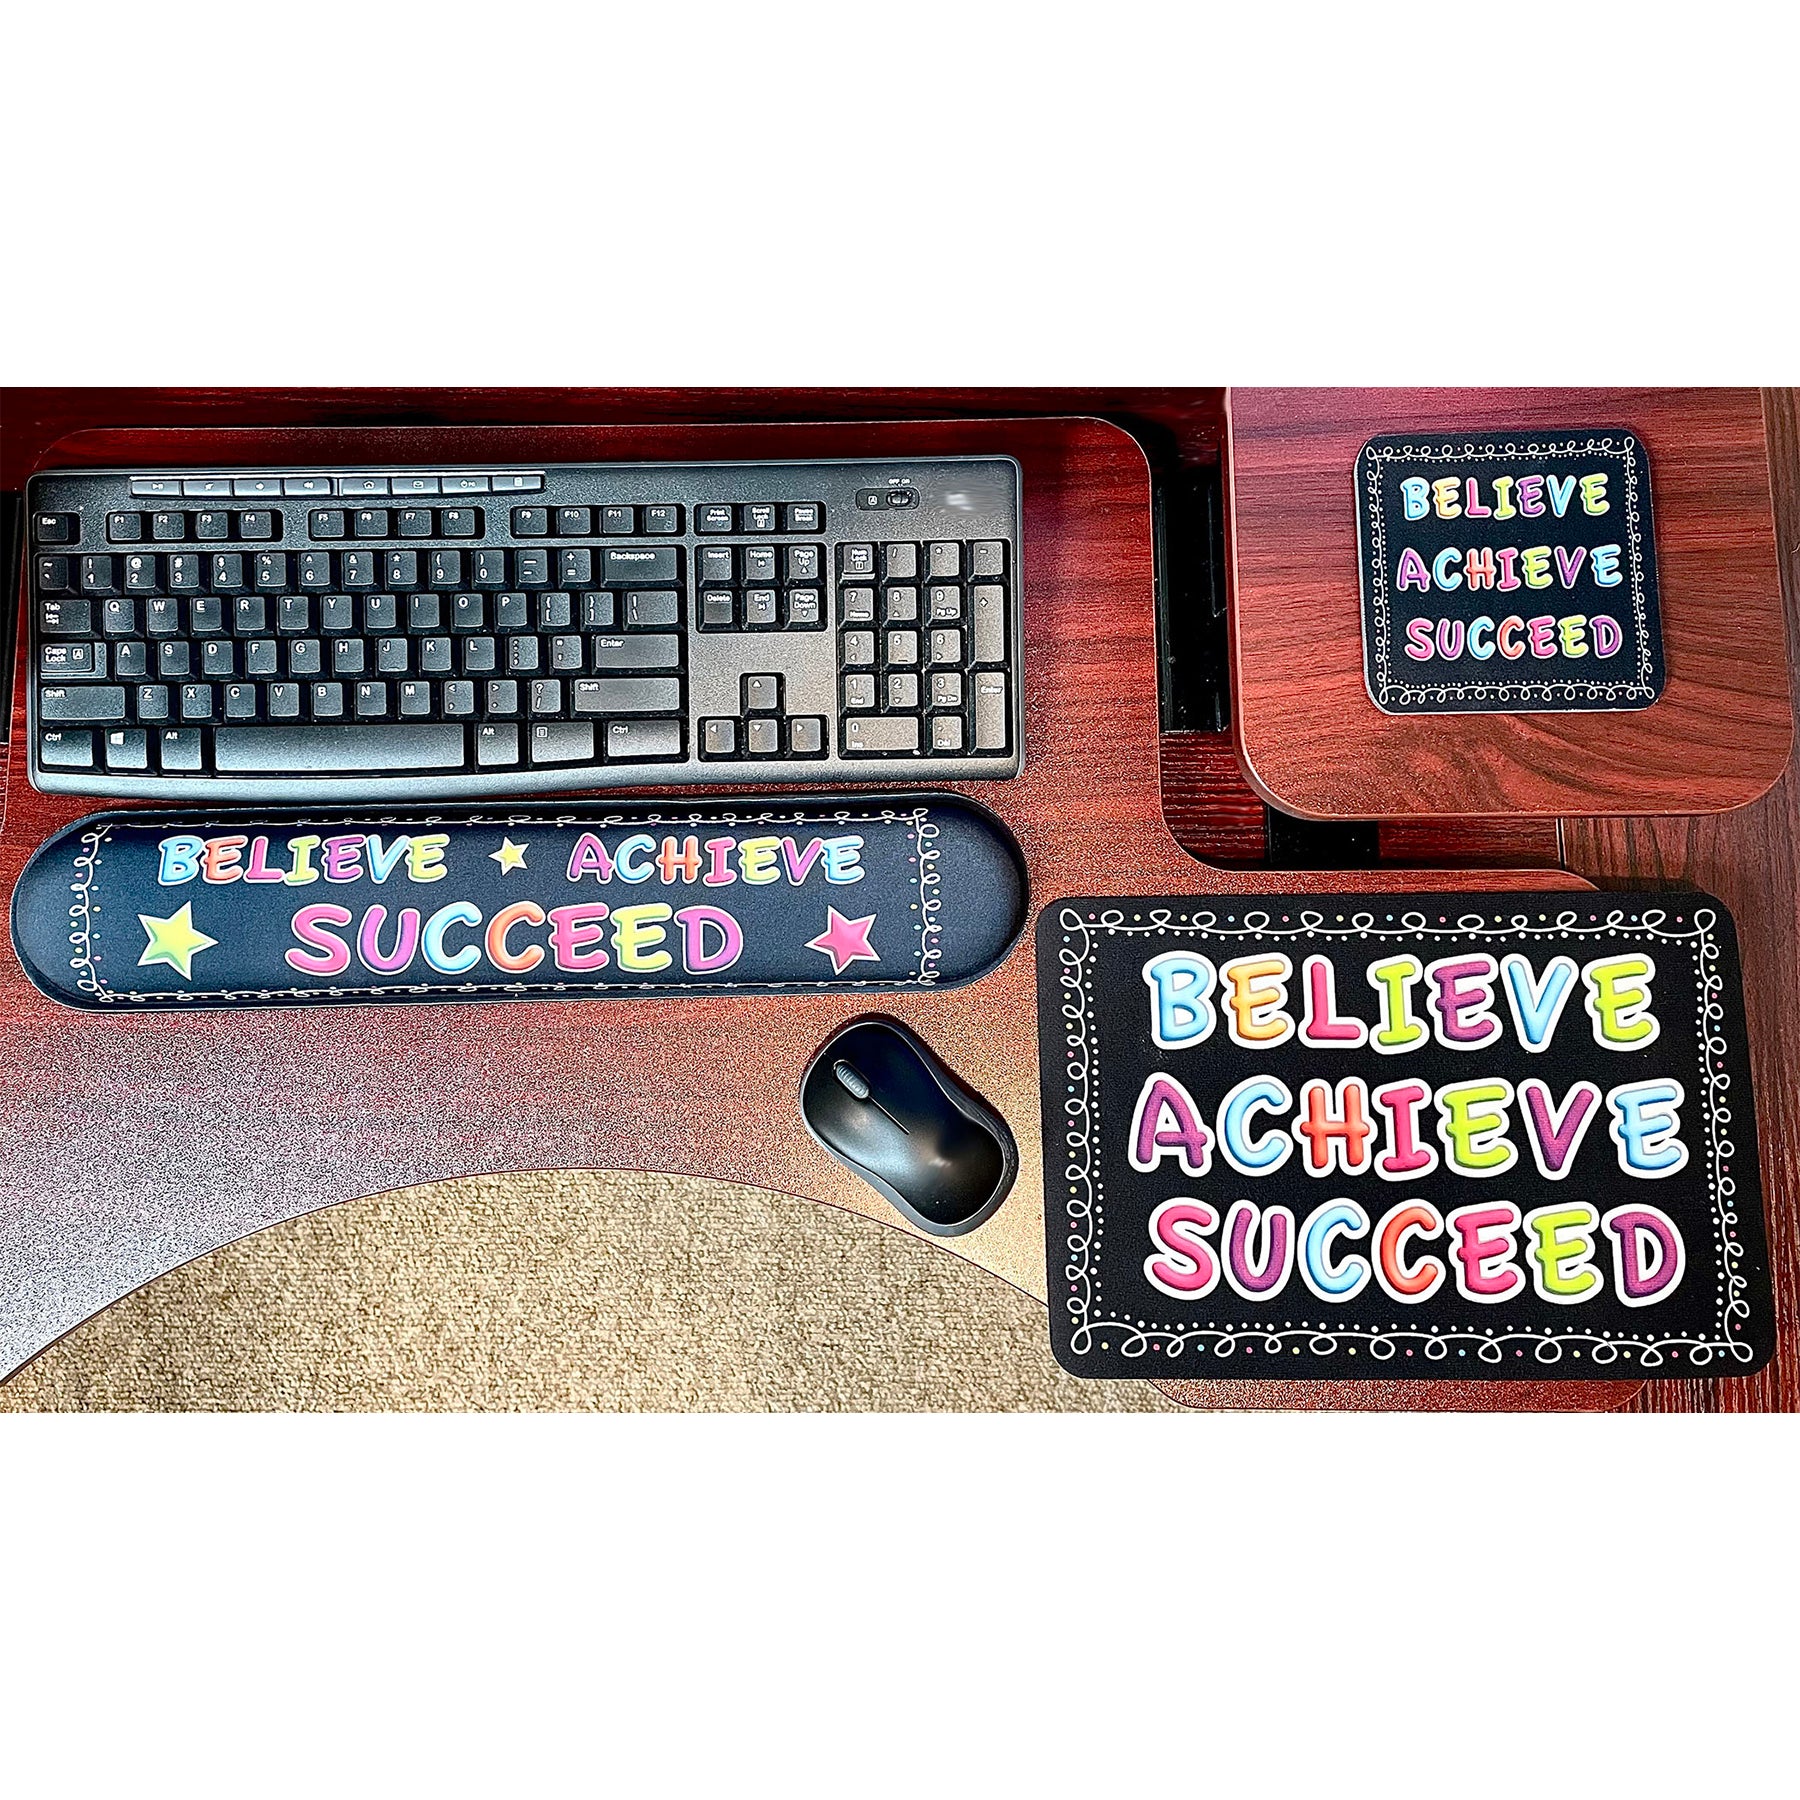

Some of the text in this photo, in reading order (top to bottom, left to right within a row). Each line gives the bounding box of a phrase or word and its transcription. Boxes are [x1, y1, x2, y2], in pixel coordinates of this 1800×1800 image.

[1400, 472, 1610, 521] BELIEVE
[565, 510, 579, 518] F10
[42, 517, 57, 525] Esc
[114, 516, 124, 524] F1
[349, 555, 357, 563] &
[610, 552, 656, 561] Backspace
[794, 550, 814, 558] Page
[88, 558, 92, 569] !
[131, 558, 141, 568] @
[174, 557, 183, 567] #
[217, 556, 225, 567] $
[262, 556, 271, 565] %
[799, 558, 810, 566] Up
[1396, 543, 1623, 592] ACHIEVE
[87, 573, 95, 584] 1
[131, 572, 138, 583] 2
[174, 572, 182, 582] 3
[218, 571, 227, 582] 4
[262, 571, 270, 581] 5
[306, 571, 314, 581] 6
[350, 571, 357, 580] 7
[393, 570, 401, 579] 8
[436, 570, 444, 579] 9
[480, 569, 487, 579] 0
[893, 592, 900, 601] 8
[936, 591, 944, 600] 9
[45, 602, 60, 611] Tab
[153, 601, 165, 611] W
[196, 601, 205, 611] E
[240, 600, 250, 610] R
[285, 600, 292, 609] T
[328, 599, 336, 609] Y
[371, 599, 380, 608] U
[415, 598, 418, 608] I
[502, 597, 510, 606] P
[794, 601, 816, 609] Down
[110, 602, 120, 612] Q
[850, 636, 858, 646] 4
[894, 635, 901, 645] 5
[937, 634, 944, 644] 6
[1404, 614, 1623, 661] SUCCEED
[121, 645, 130, 655] A
[164, 645, 173, 655] S
[208, 644, 217, 654] D
[252, 644, 259, 653] F
[296, 643, 306, 653] G
[339, 643, 348, 652] H
[382, 642, 390, 651] J
[426, 641, 435, 651] K
[470, 641, 477, 650] L
[45, 647, 67, 655] Caps
[579, 683, 599, 691] Shift
[850, 679, 857, 689] 1
[894, 678, 901, 688] 2
[938, 678, 945, 687] 3
[45, 689, 65, 697] Shift
[187, 688, 196, 698] X
[231, 687, 240, 697] C
[275, 687, 284, 697] V
[318, 687, 326, 696] B
[361, 686, 371, 696] N
[405, 685, 415, 695] M
[535, 683, 543, 693] ?
[144, 689, 153, 698] Z
[482, 727, 495, 735] Alt
[612, 726, 628, 734] Ctrl
[852, 723, 859, 732] 0
[45, 733, 62, 741] Ctrl
[165, 732, 178, 740] Alt
[157, 832, 865, 887] BELIEVE ACHIEVE
[283, 901, 744, 977] SUCCEED
[1141, 950, 1660, 1054] BELIEVE
[1128, 1072, 1689, 1182] ACHIEVE
[1144, 1197, 1686, 1308] SUCCEED
